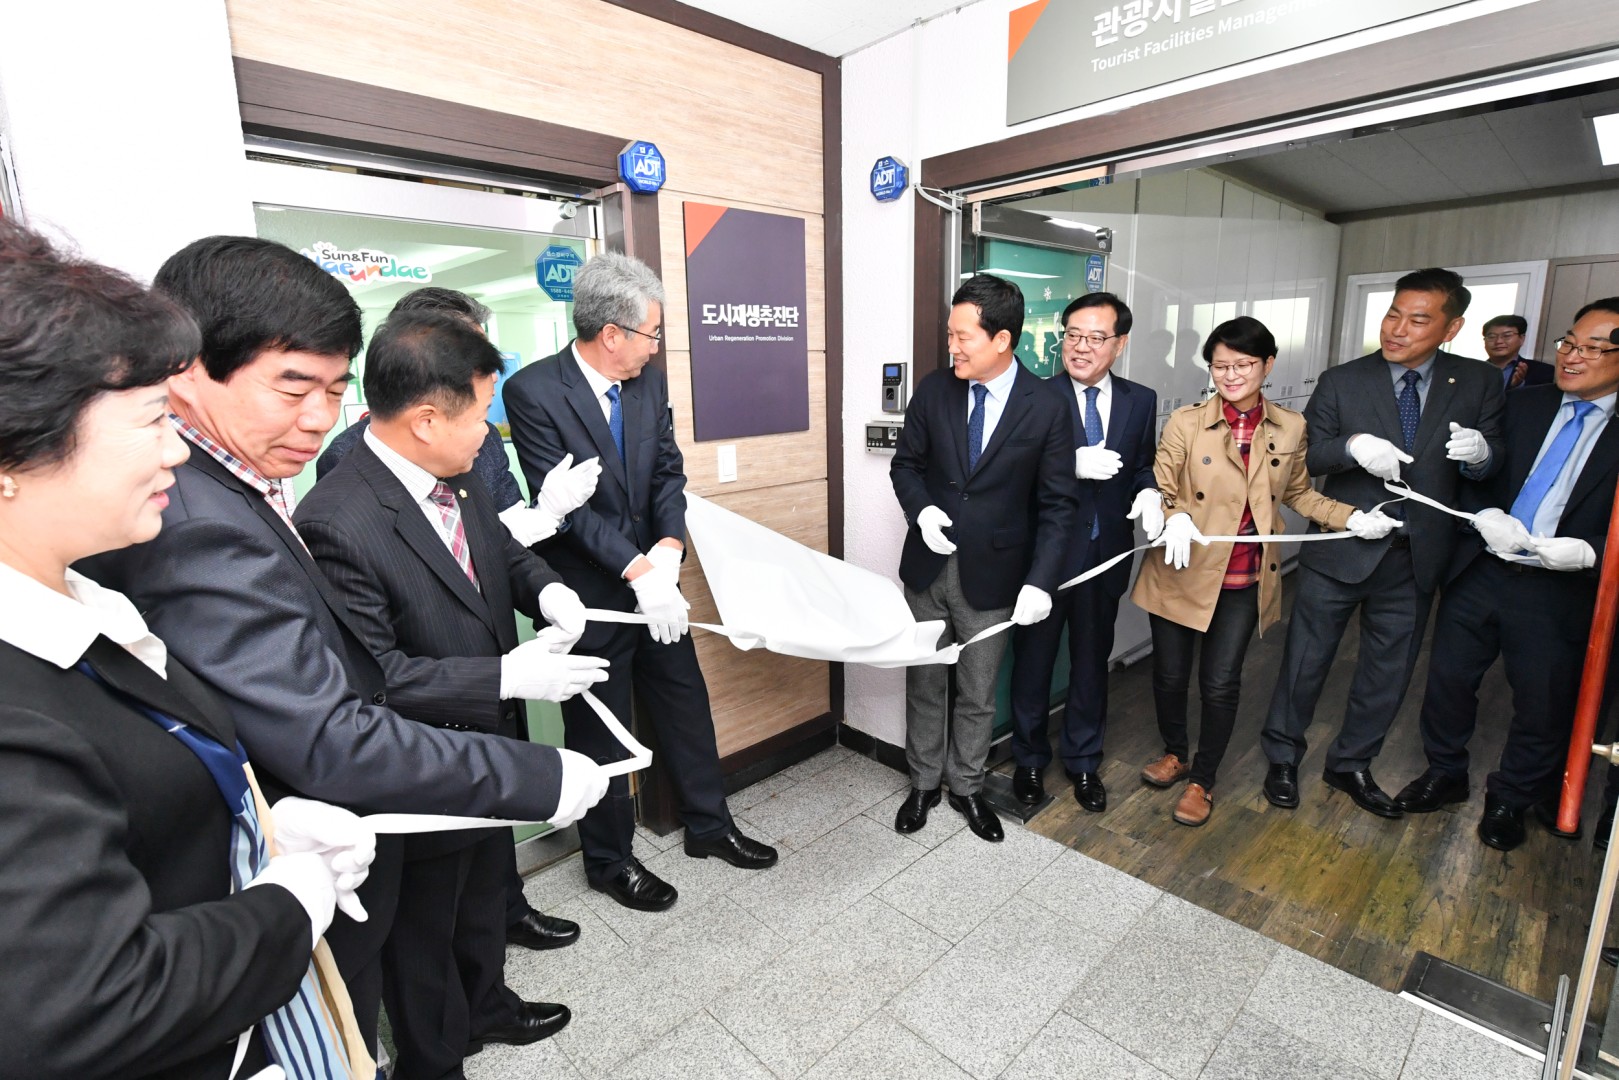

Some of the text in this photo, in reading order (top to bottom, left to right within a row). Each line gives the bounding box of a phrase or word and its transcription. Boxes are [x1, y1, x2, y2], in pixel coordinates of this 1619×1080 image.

[1091, 46, 1141, 73] Tourist
[1143, 26, 1214, 57] Facilities
[635, 158, 660, 177] ADT
[874, 168, 895, 188] ADT
[322, 249, 389, 264] Sun&Fun
[546, 263, 577, 283] ADT
[1088, 267, 1102, 282] ADT
[702, 303, 799, 328] 도시재생추진단
[708, 334, 724, 342] Urban
[724, 334, 755, 343] Regeneration
